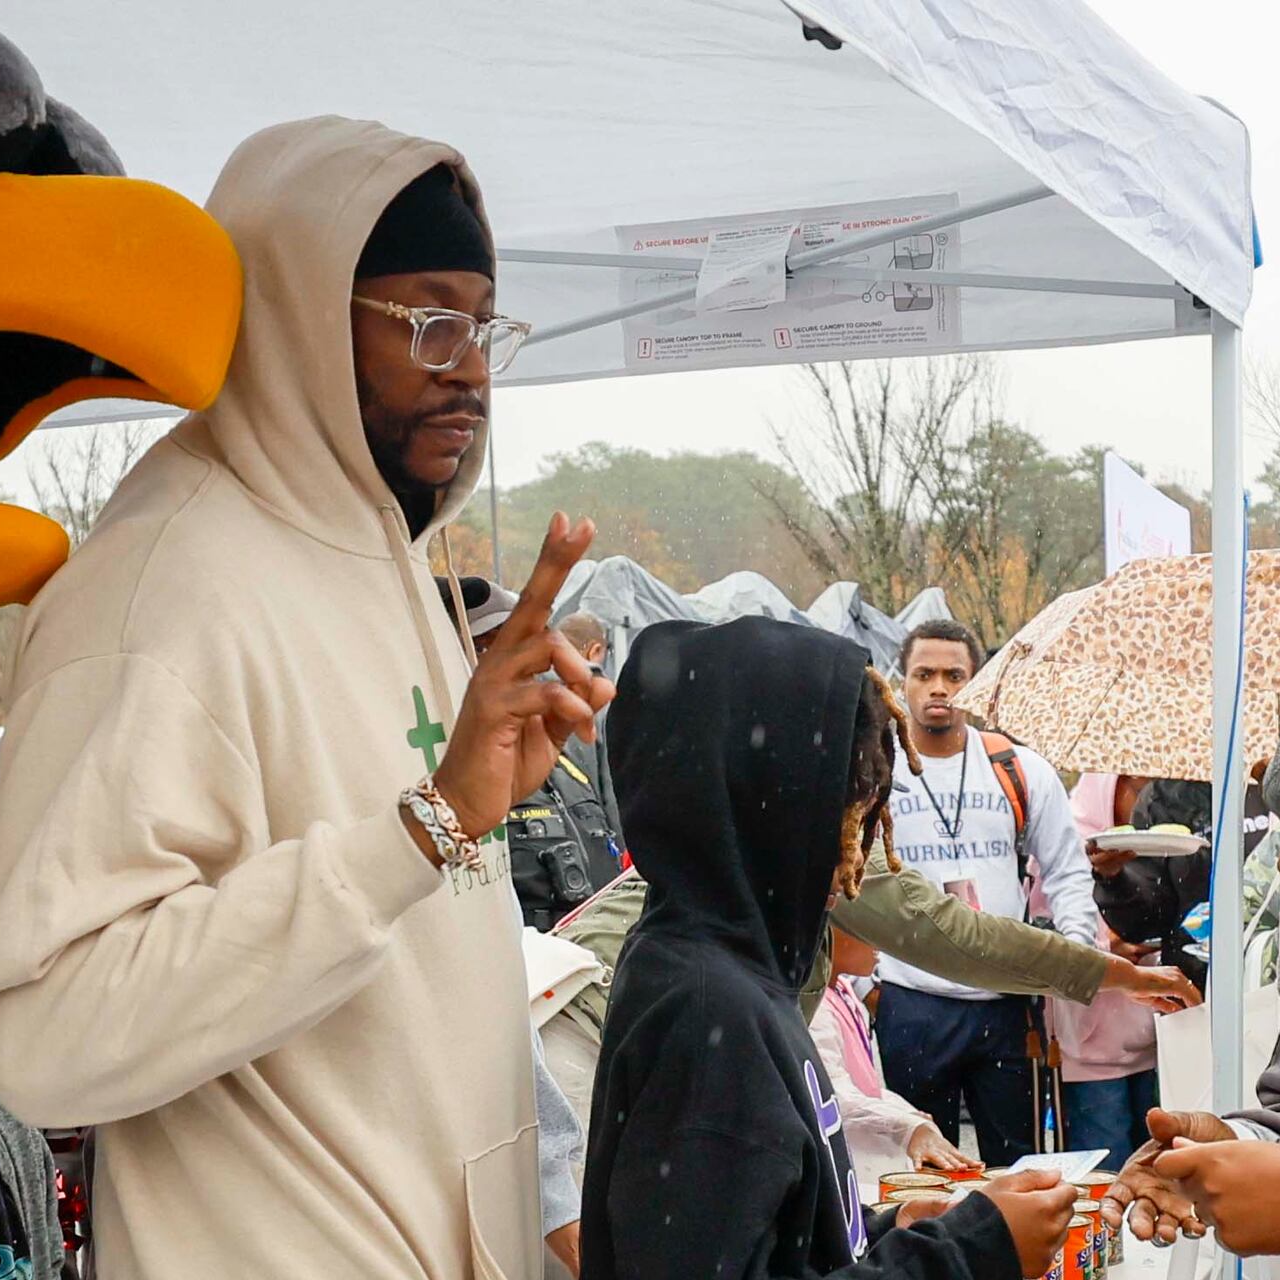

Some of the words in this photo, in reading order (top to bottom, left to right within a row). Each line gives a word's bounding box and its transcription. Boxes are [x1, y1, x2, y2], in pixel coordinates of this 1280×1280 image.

[861, 218, 892, 229] STRONG
[673, 237, 699, 246] BEFORE
[855, 320, 883, 328] GROUND
[894, 790, 1010, 817] OLUMBIA
